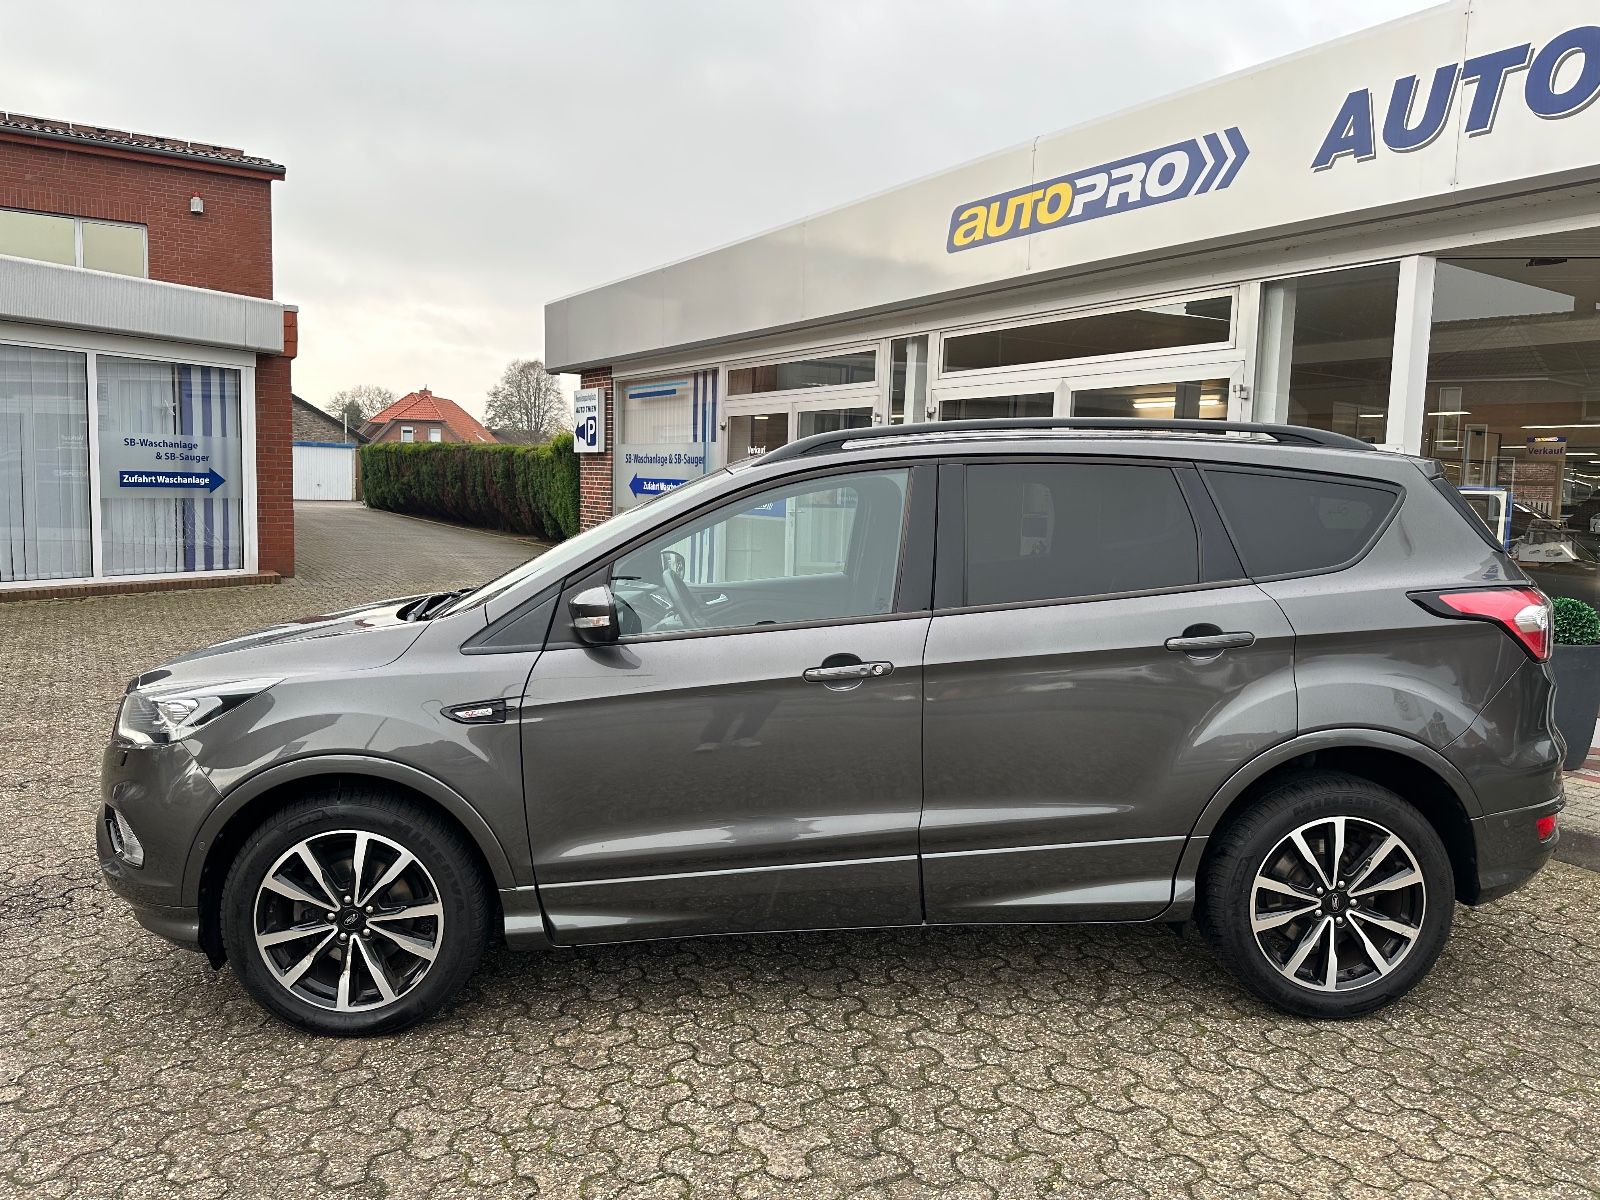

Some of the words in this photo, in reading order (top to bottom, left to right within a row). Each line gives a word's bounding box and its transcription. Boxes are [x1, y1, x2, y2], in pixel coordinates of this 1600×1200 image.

[1310, 25, 1600, 173] AUTO
[587, 419, 596, 444] P
[123, 437, 199, 451] SB-Waschanlage
[1528, 446, 1564, 455] Verkauf
[155, 452, 163, 460] &
[164, 452, 210, 463] SB-Sauger
[625, 453, 668, 467] SB-Waschanlage
[668, 453, 674, 464] &
[674, 453, 705, 468] SB-Sauger
[122, 475, 156, 484] Zufahrt
[156, 476, 210, 486] Waschanlage
[643, 481, 659, 491] Zufahrt
